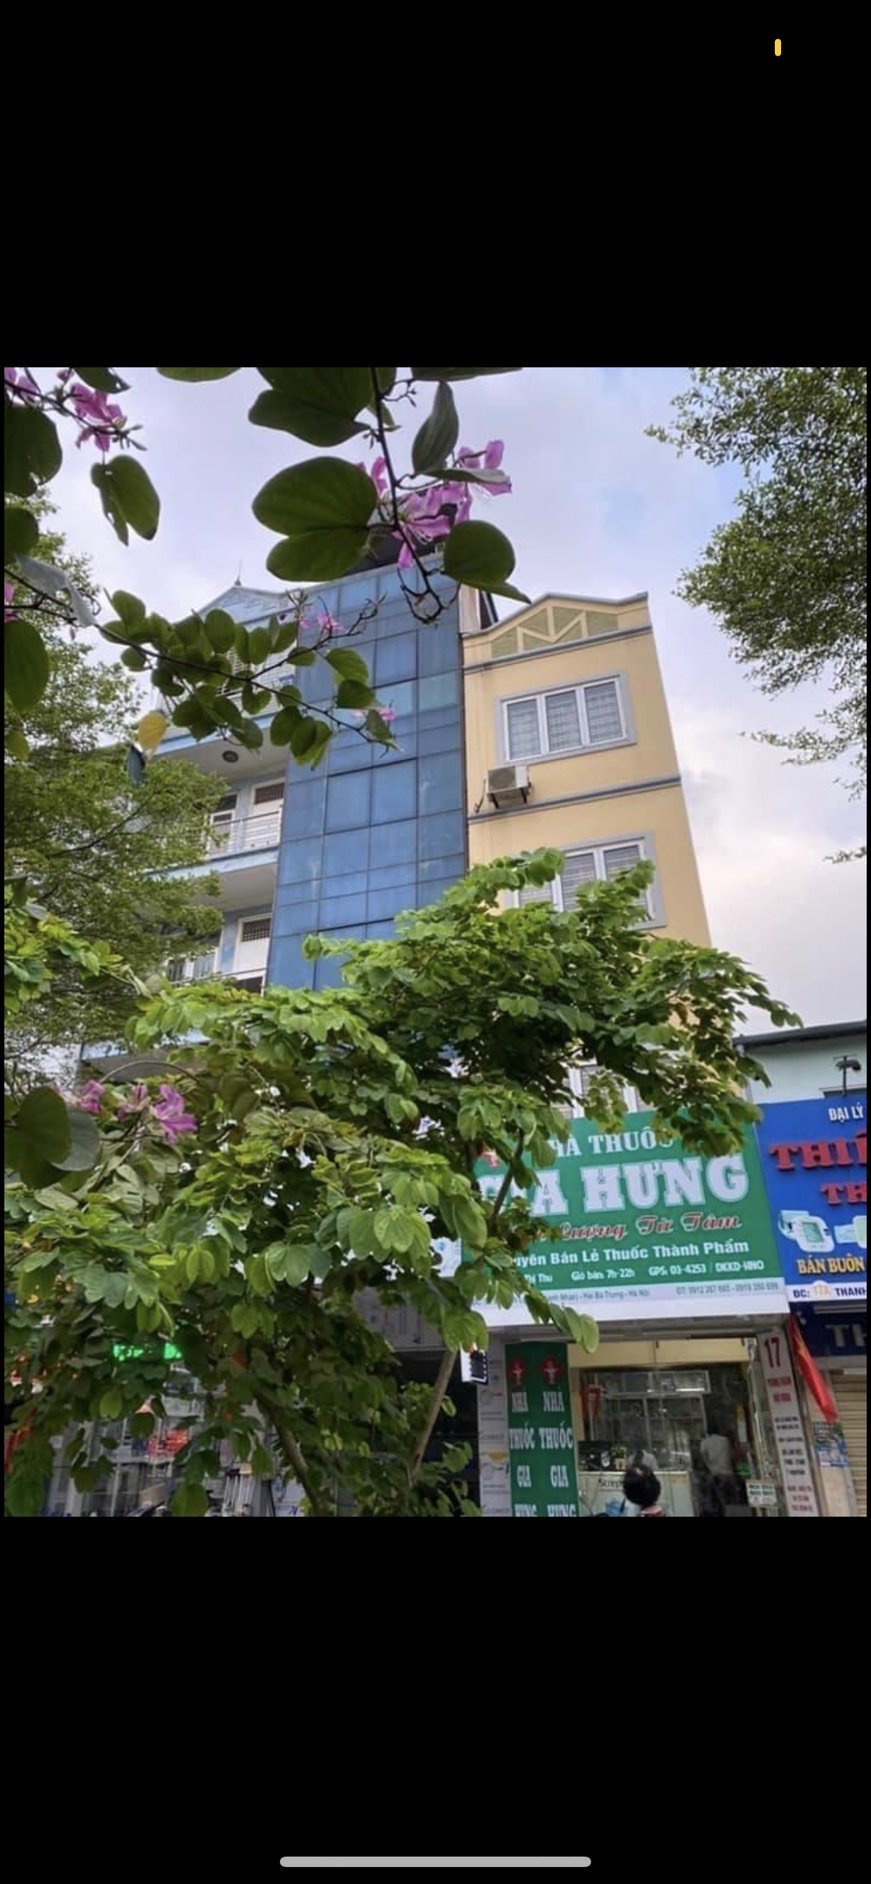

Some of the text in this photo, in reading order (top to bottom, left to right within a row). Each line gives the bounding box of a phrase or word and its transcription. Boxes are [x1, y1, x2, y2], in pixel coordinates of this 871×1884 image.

[828, 1101, 865, 1123] ĐẠI LÝ
[581, 1152, 750, 1213] HƯNG
[603, 1245, 650, 1260] Thuốc
[652, 1244, 700, 1258] Thành
[703, 1239, 750, 1254] Phẩm
[797, 1253, 866, 1275] BÁN BUÔN
[764, 1336, 781, 1368] 17
[550, 1464, 569, 1488] GIA
